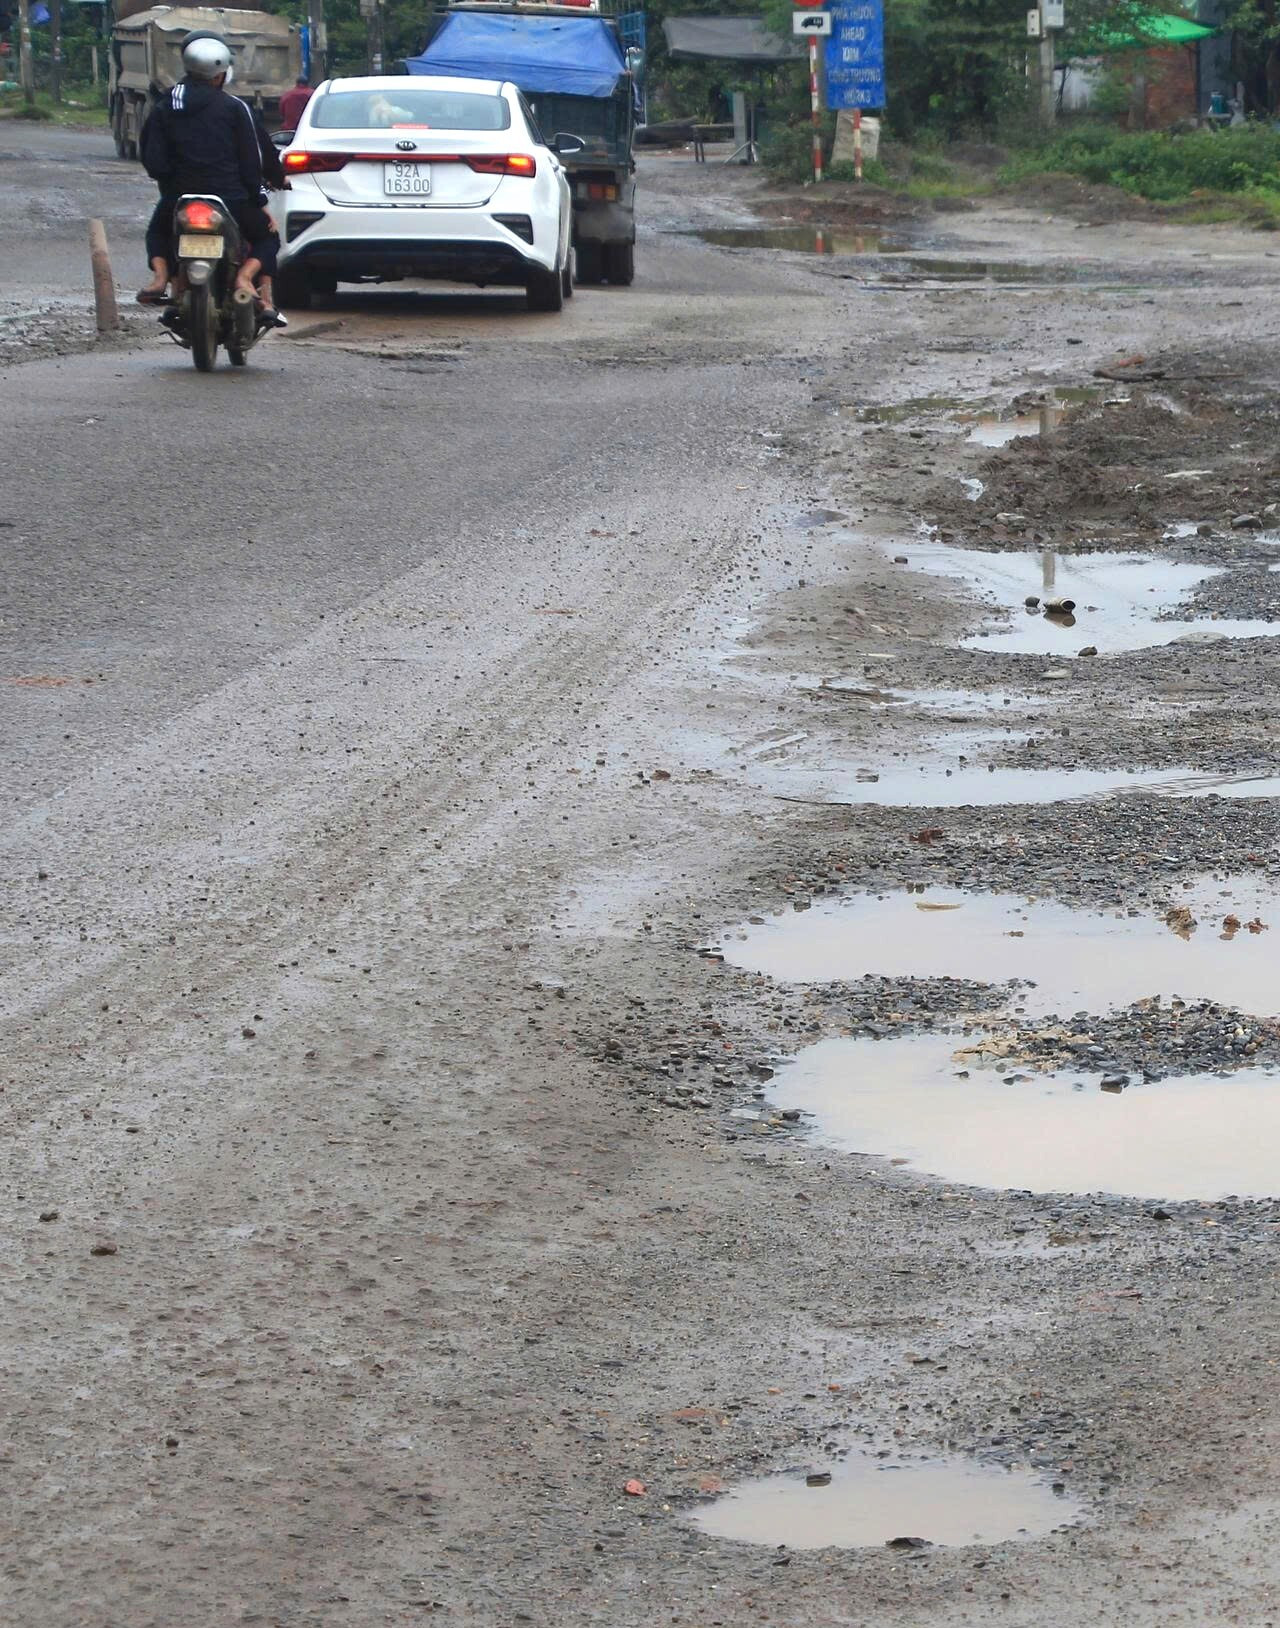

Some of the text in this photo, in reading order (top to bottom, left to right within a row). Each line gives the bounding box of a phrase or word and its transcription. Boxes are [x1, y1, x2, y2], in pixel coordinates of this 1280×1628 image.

[840, 26, 864, 40] AHEAD
[843, 87, 871, 104] WORKS
[395, 164, 420, 178] 92A
[386, 178, 430, 192] 163.00
